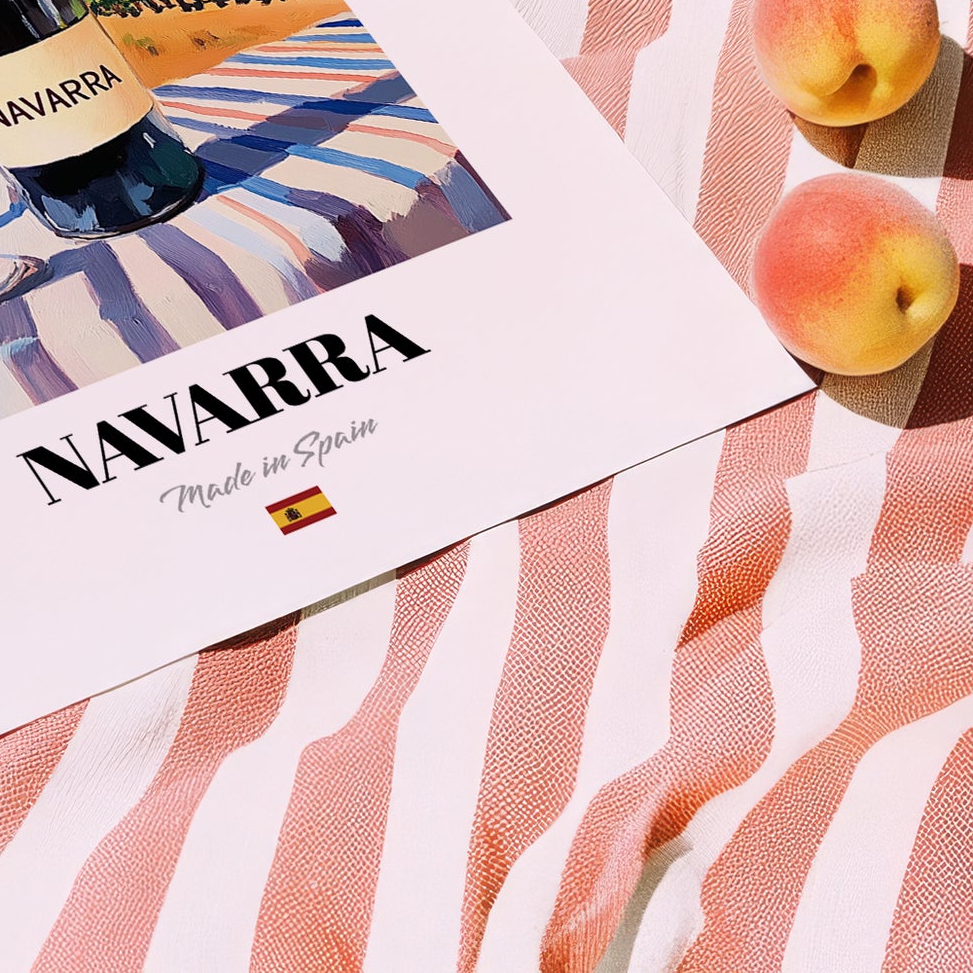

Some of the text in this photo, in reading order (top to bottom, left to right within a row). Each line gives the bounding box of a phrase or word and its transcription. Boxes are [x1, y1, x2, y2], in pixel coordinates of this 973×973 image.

[16, 314, 431, 505] NAVARRA
[159, 418, 378, 513] Made in Spain
